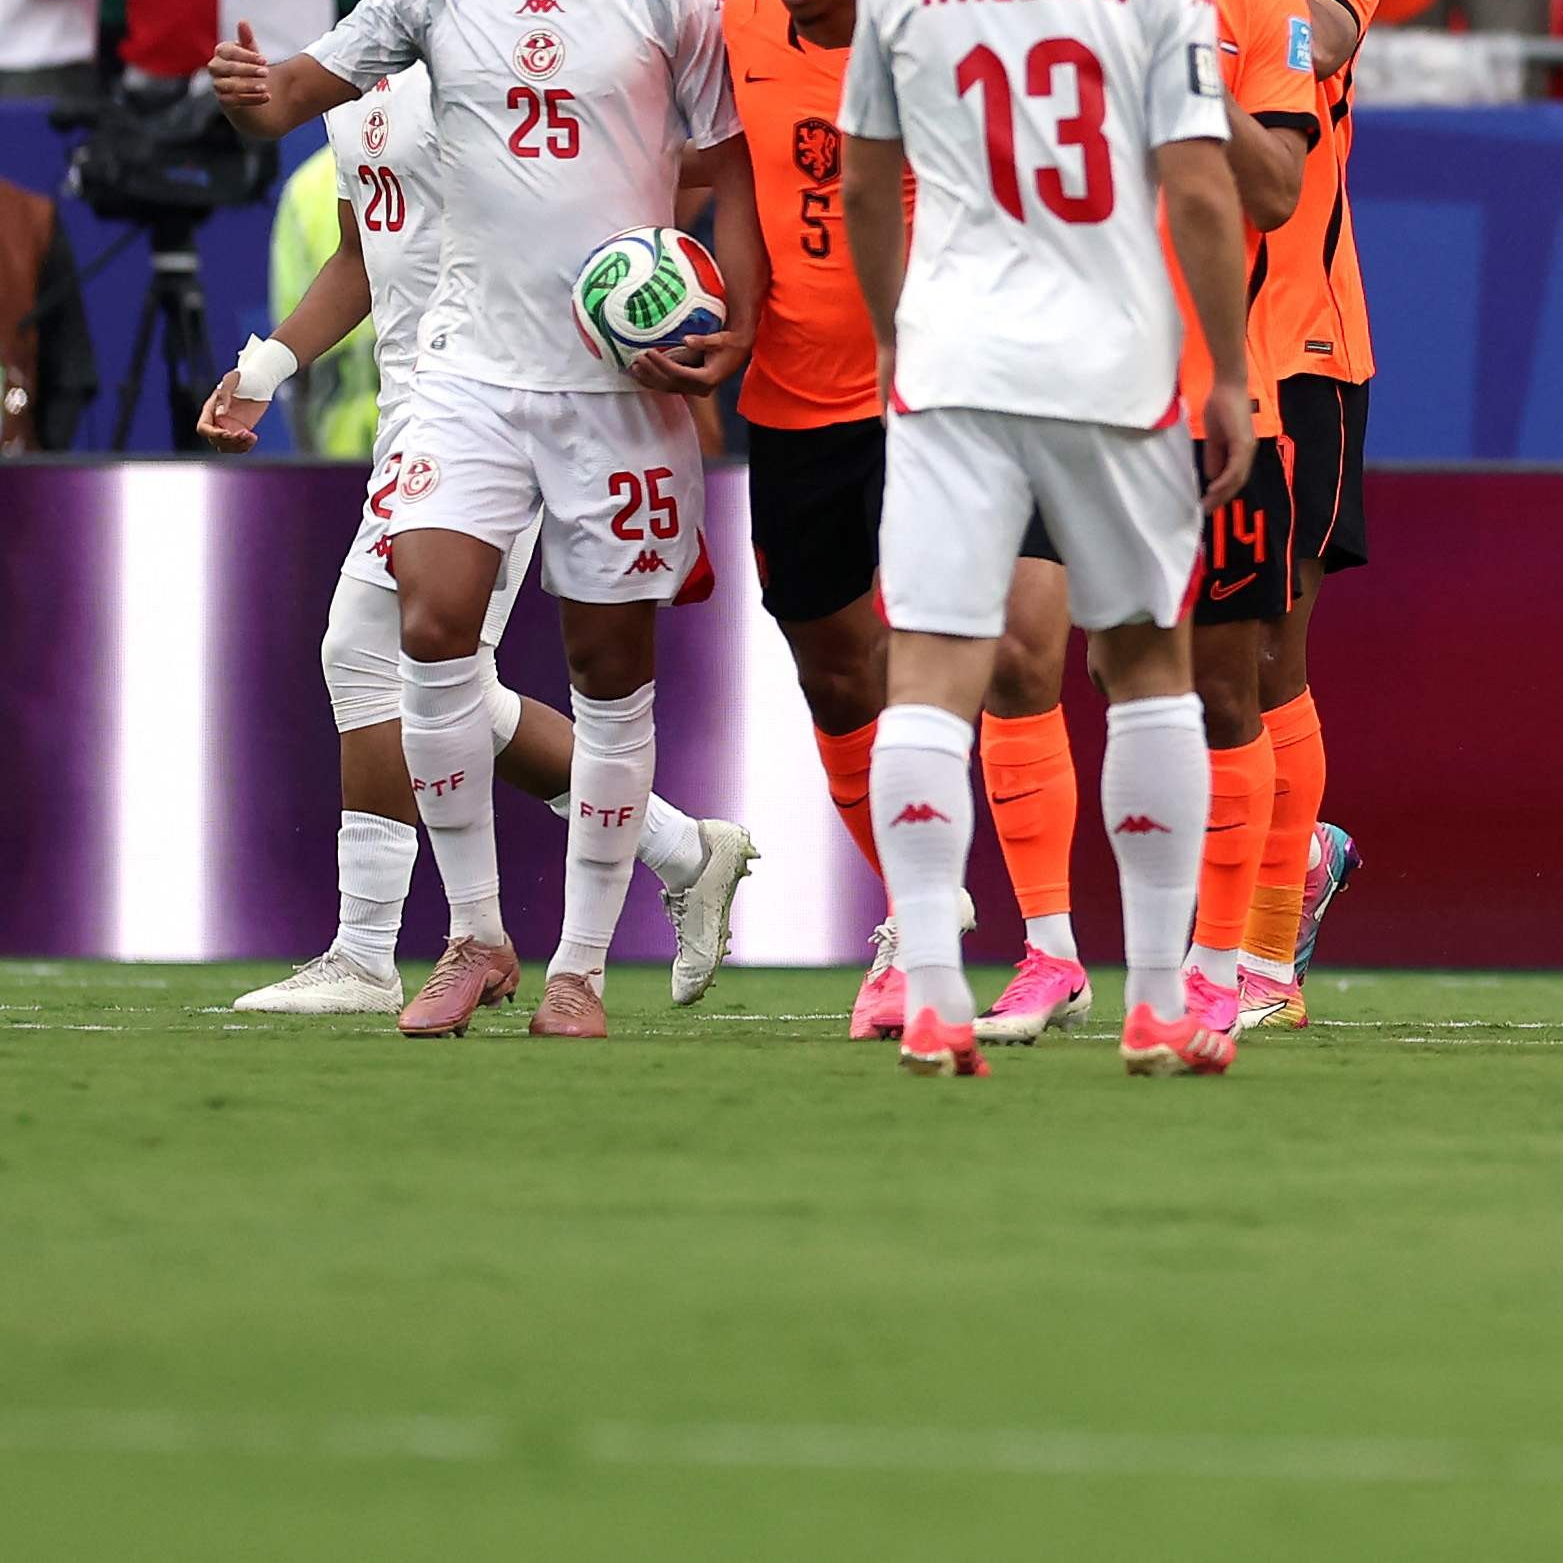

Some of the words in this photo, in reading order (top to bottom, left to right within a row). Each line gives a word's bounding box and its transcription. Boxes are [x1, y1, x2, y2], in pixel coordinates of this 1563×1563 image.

[506, 86, 580, 160] 25
[955, 36, 1116, 225] 13
[357, 164, 406, 233] 20
[800, 189, 832, 259] 5
[608, 466, 680, 541] 25
[1211, 499, 1266, 570] 14
[411, 770, 466, 798] FTF
[580, 801, 635, 828] FTF
